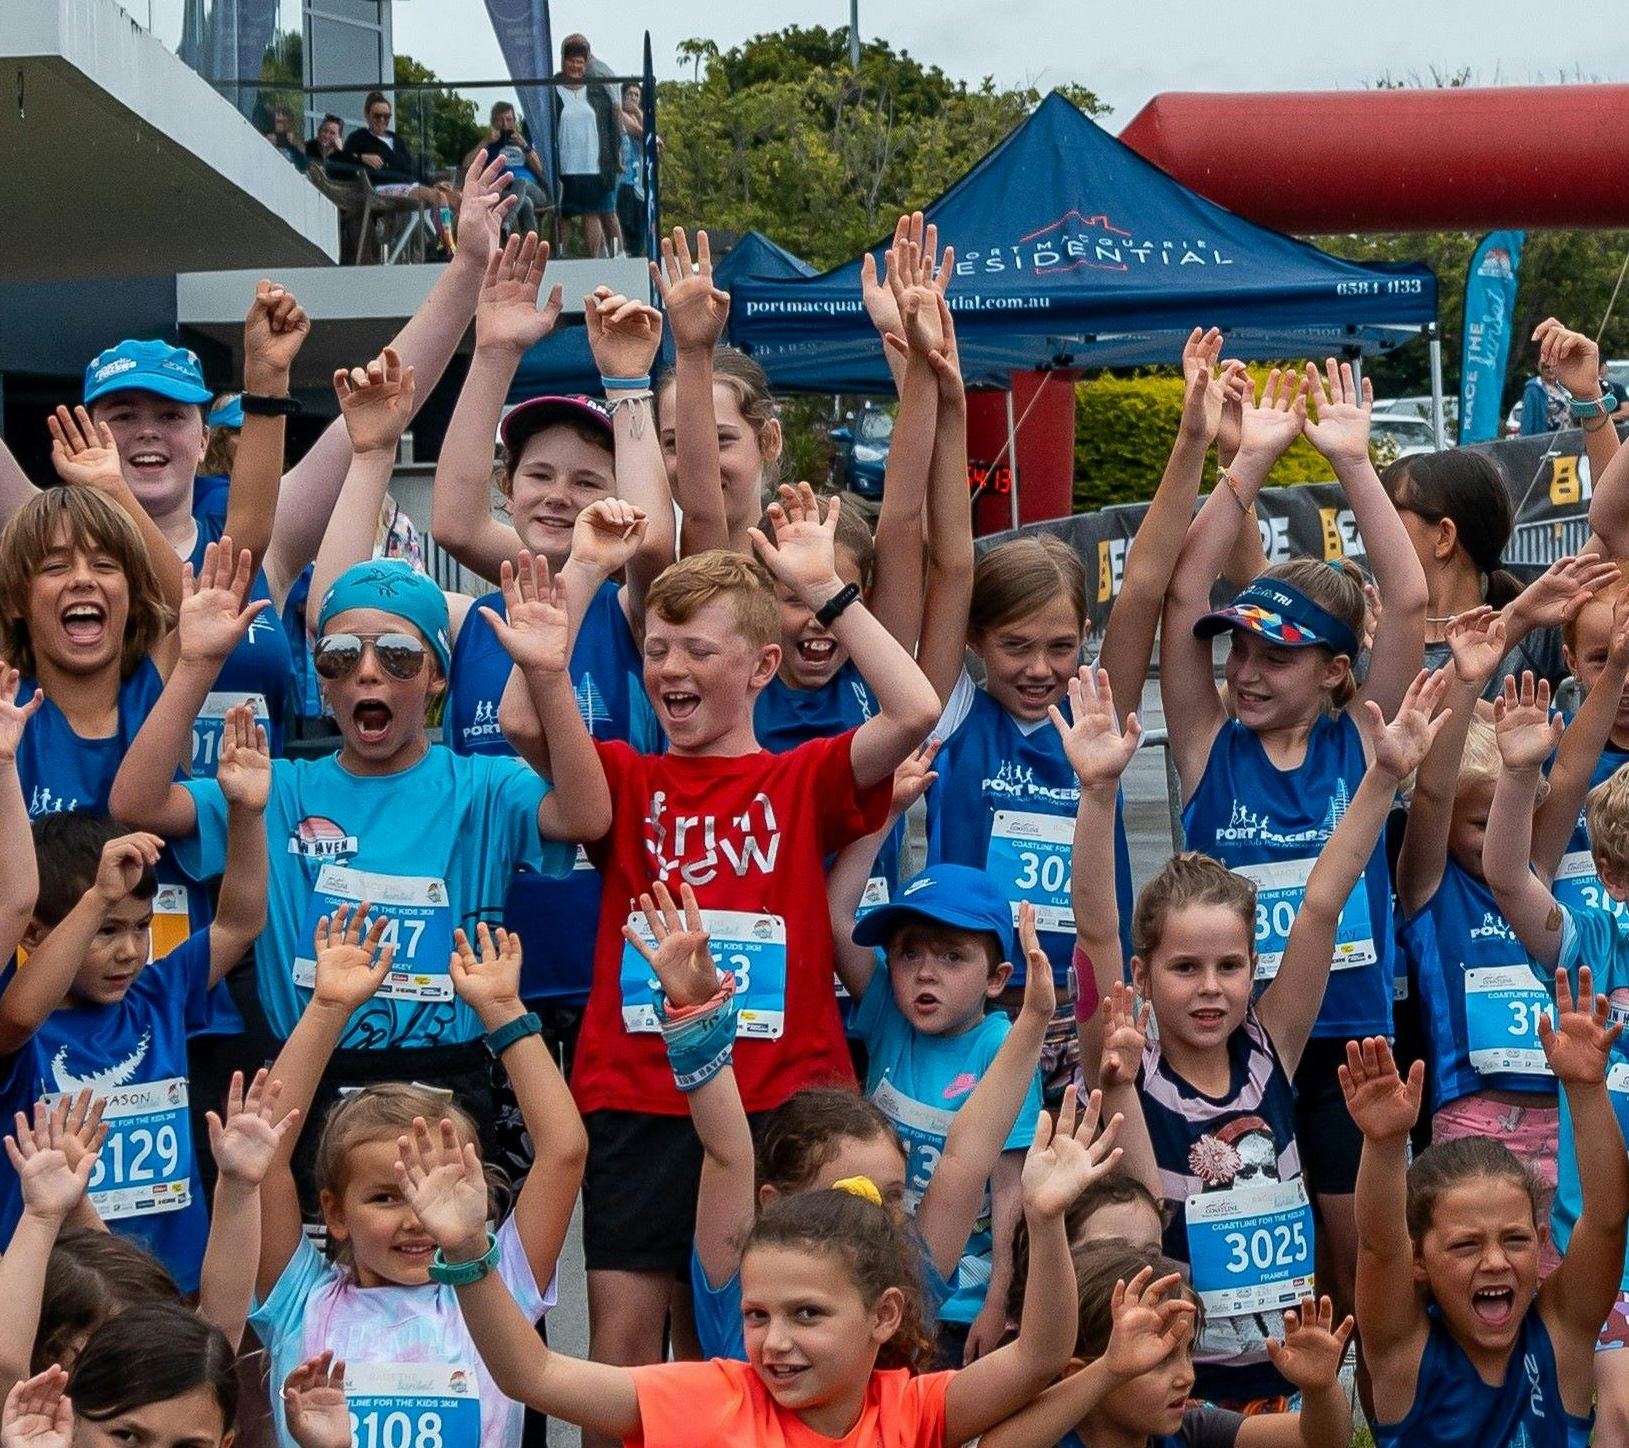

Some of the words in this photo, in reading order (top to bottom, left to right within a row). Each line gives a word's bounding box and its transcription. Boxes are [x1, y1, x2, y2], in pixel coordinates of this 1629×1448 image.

[957, 239, 1232, 275] ESIDENTIAL
[966, 245, 1020, 261] ORT
[1037, 233, 1206, 253] MACQUARIE
[1470, 322, 1483, 364] THE
[1464, 369, 1477, 431] RACE
[1273, 592, 1293, 606] TRI
[982, 778, 1023, 796] PORT
[1216, 827, 1256, 841] PORT
[1260, 828, 1332, 844] PACERS
[698, 1050, 729, 1079] HAVEN
[1212, 1220, 1256, 1231] COASTLINE
[1258, 1218, 1273, 1228] FOR
[1225, 1222, 1307, 1273] 3025
[1523, 1353, 1545, 1419] 2XU
[373, 1398, 393, 1406] FOR
[396, 1399, 413, 1407] THE
[416, 1399, 438, 1407] KIDS
[440, 1400, 458, 1408] 3KM
